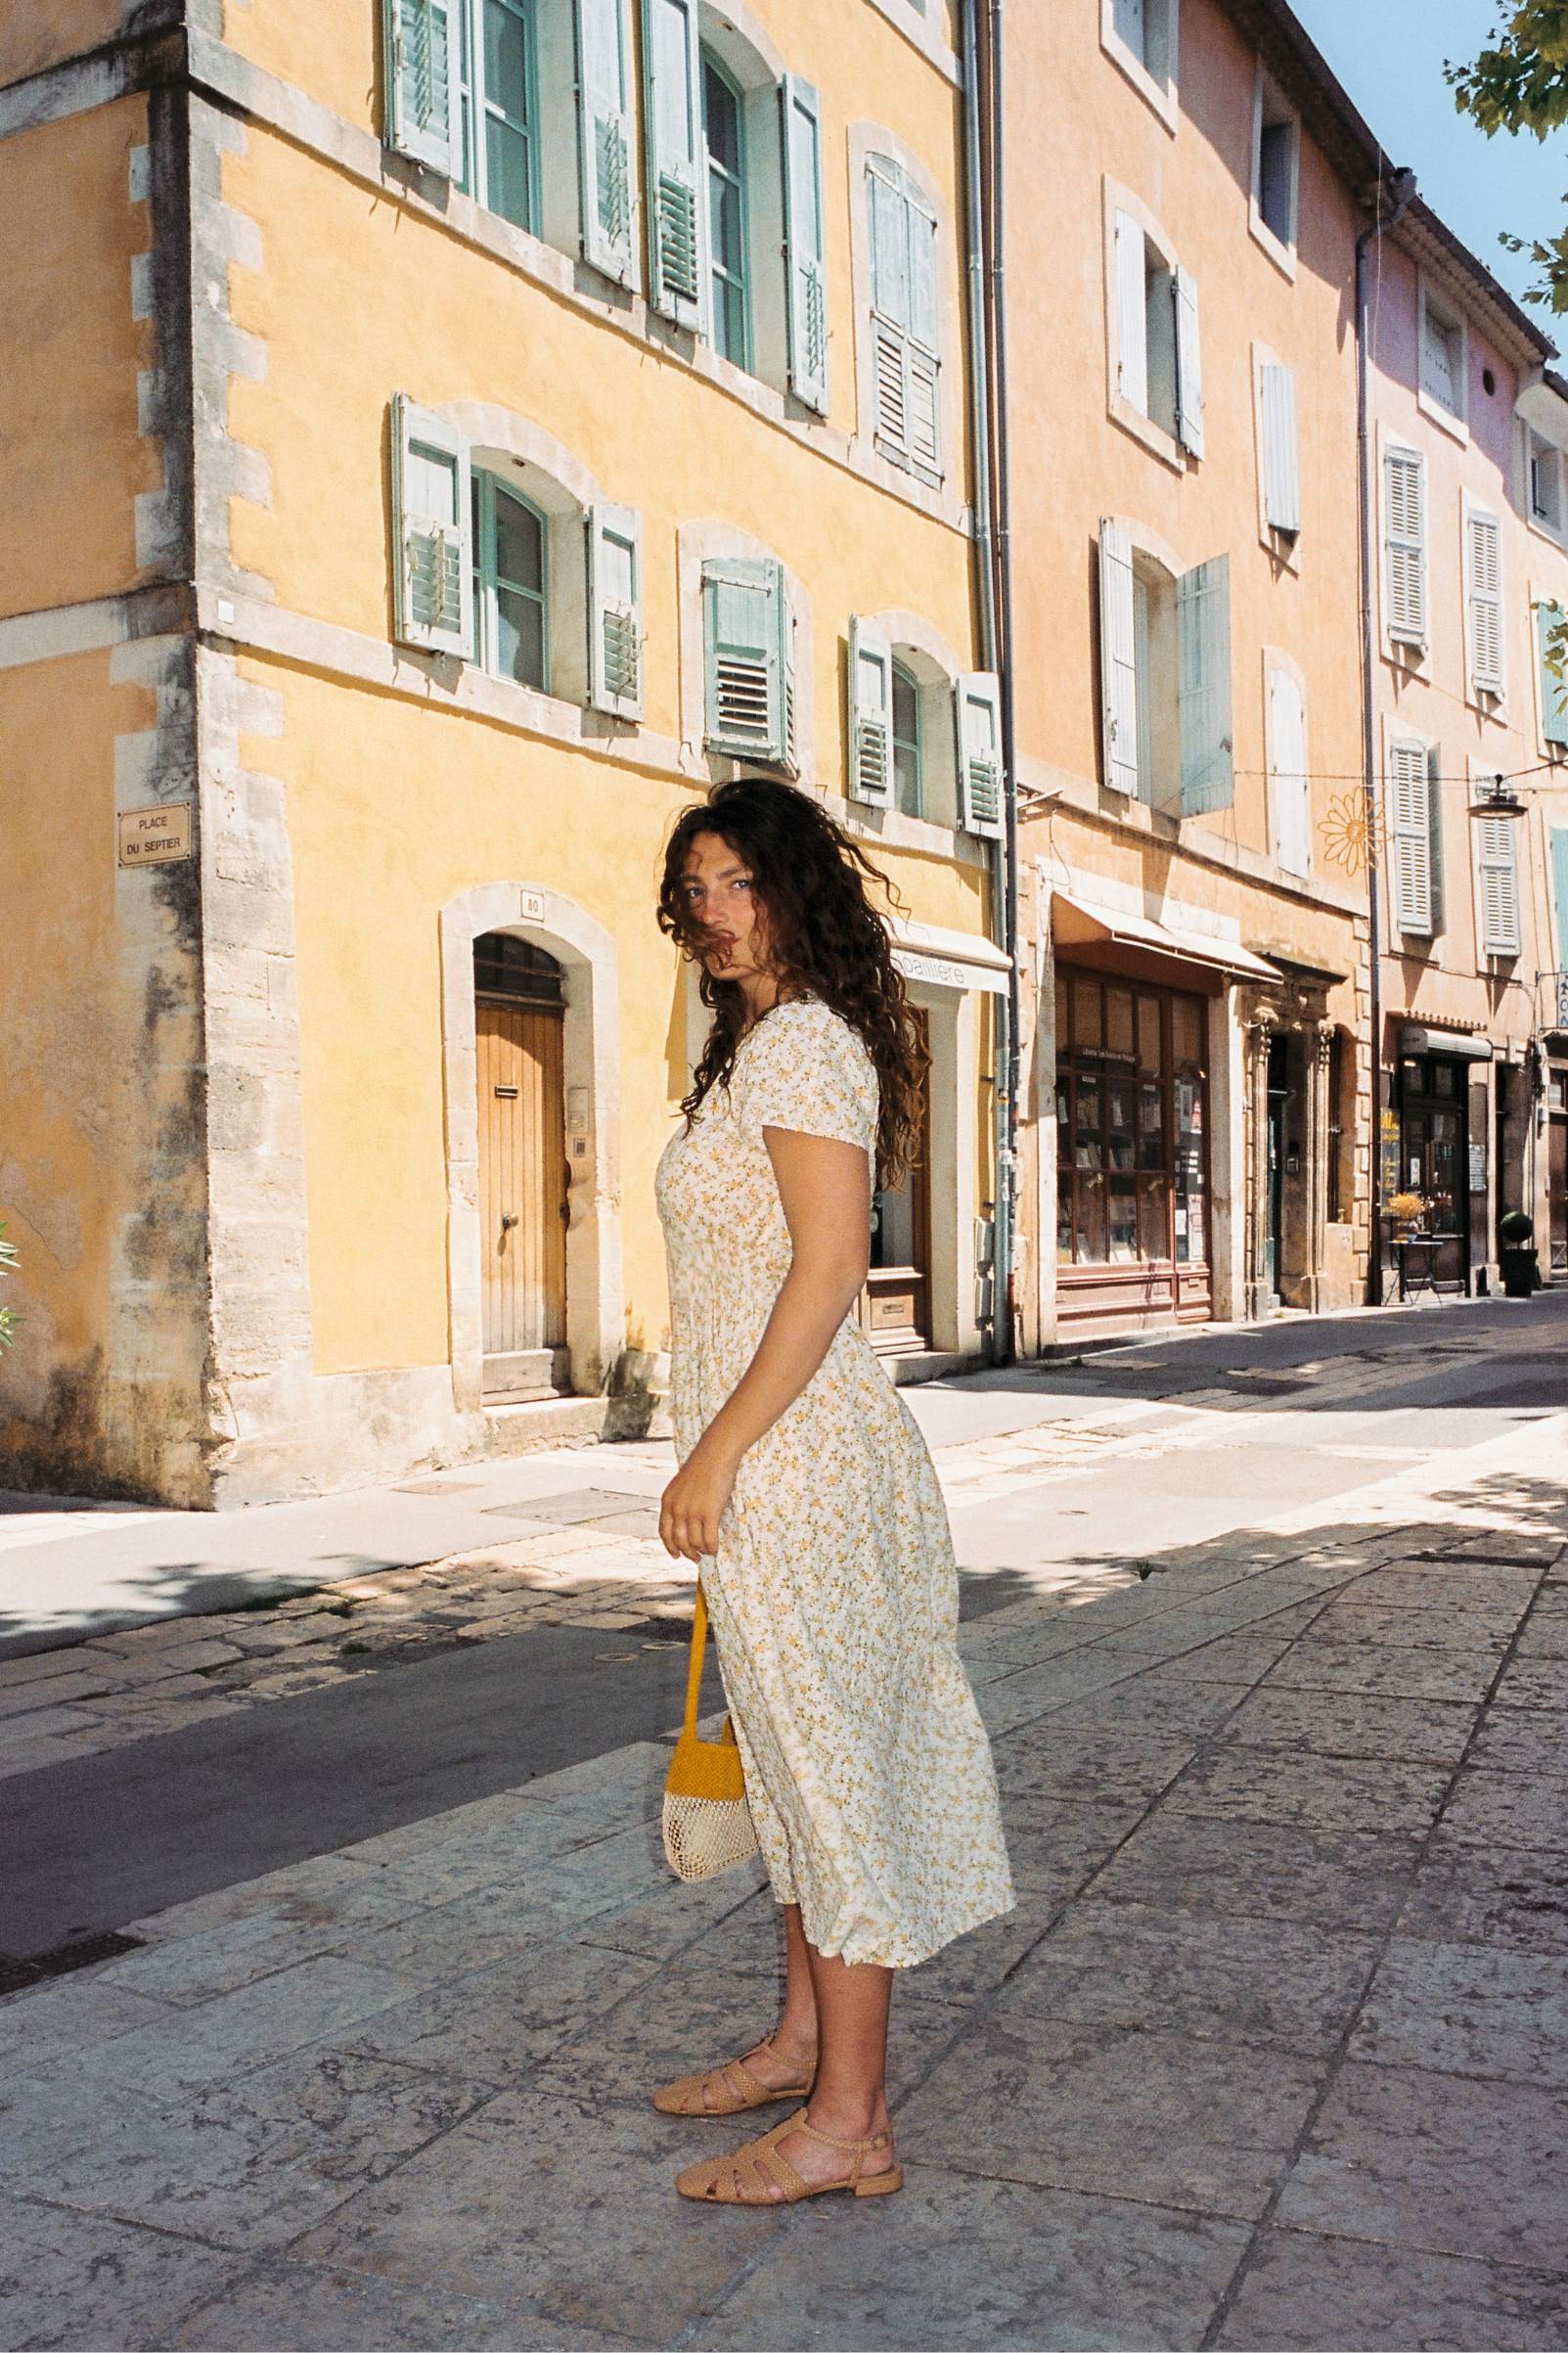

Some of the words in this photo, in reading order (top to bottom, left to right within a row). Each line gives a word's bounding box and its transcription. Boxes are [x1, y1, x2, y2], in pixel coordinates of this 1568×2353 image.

[139, 816, 167, 830] PLACE
[126, 843, 140, 854] DU
[145, 837, 181, 852] SEPTIER
